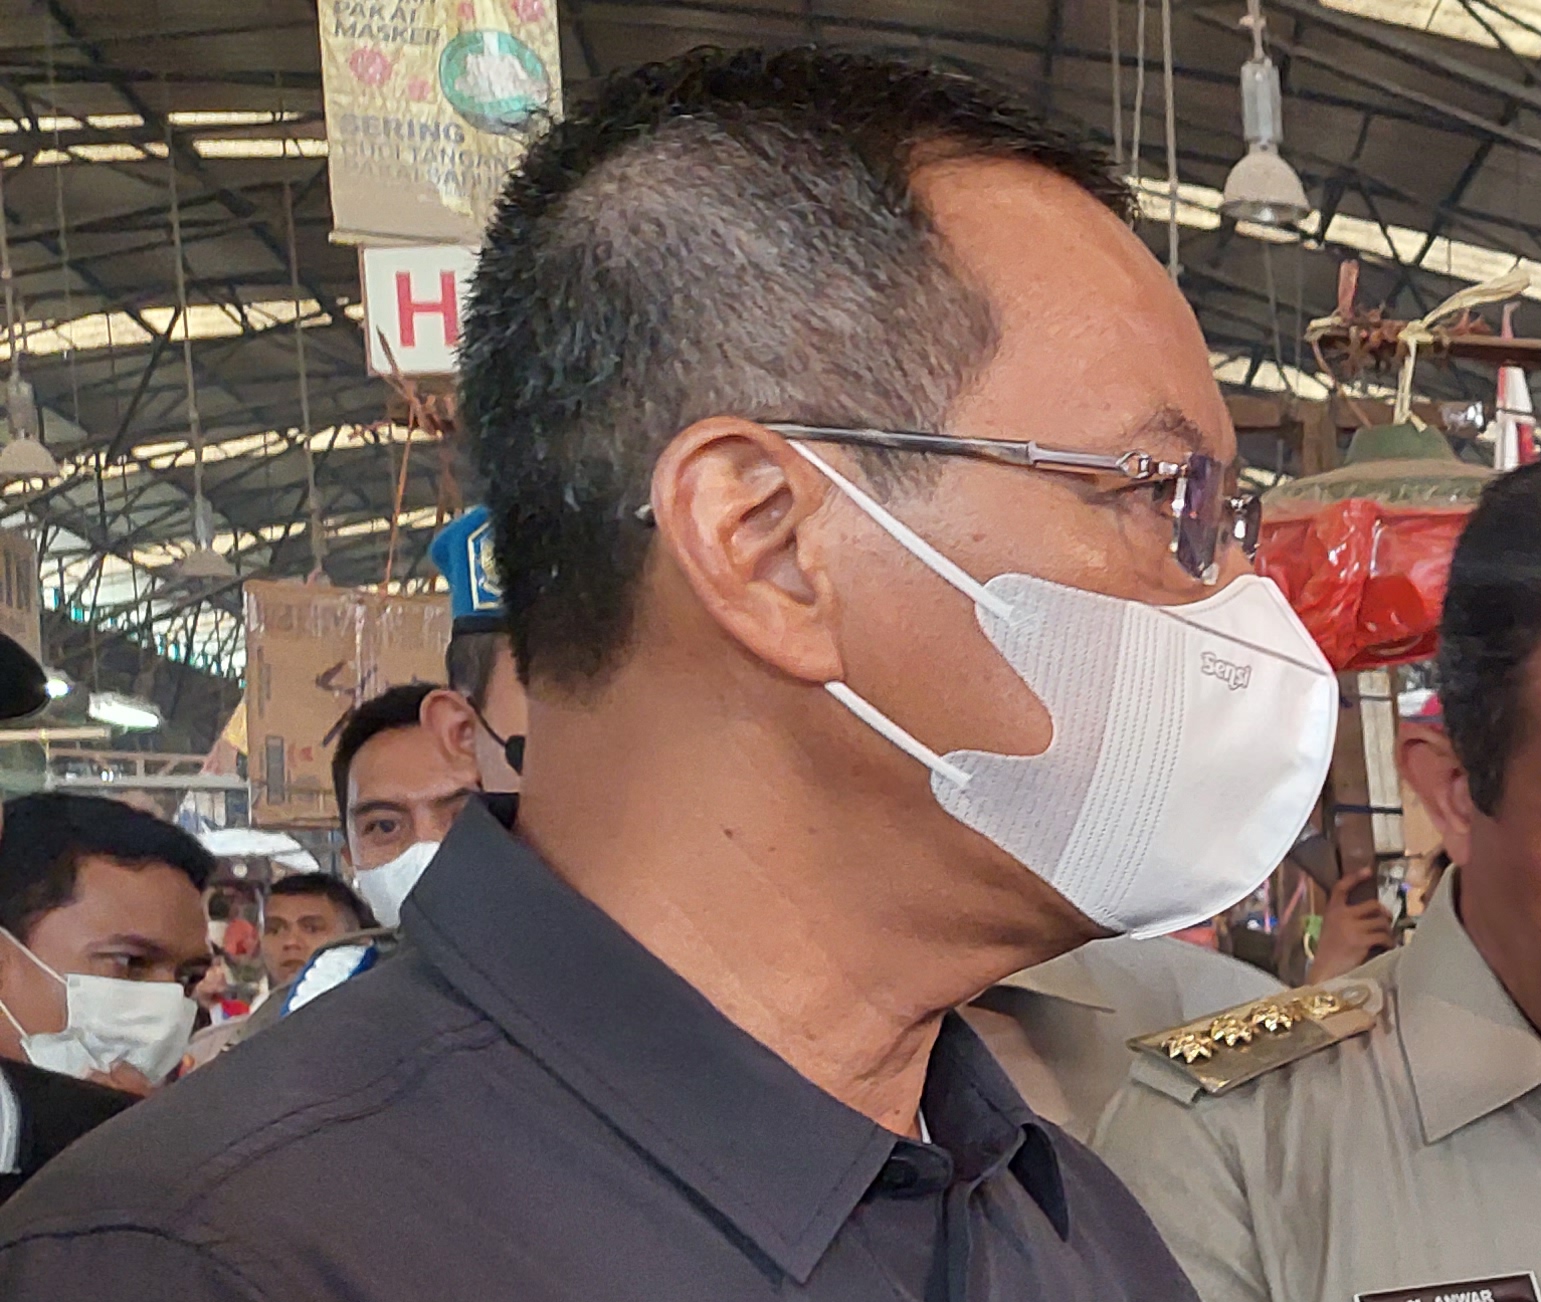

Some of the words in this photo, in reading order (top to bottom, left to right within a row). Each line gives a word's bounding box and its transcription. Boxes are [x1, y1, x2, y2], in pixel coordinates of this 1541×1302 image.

[339, 113, 466, 143] SERING
[396, 271, 459, 347] H
[1201, 651, 1251, 691] Sensi
